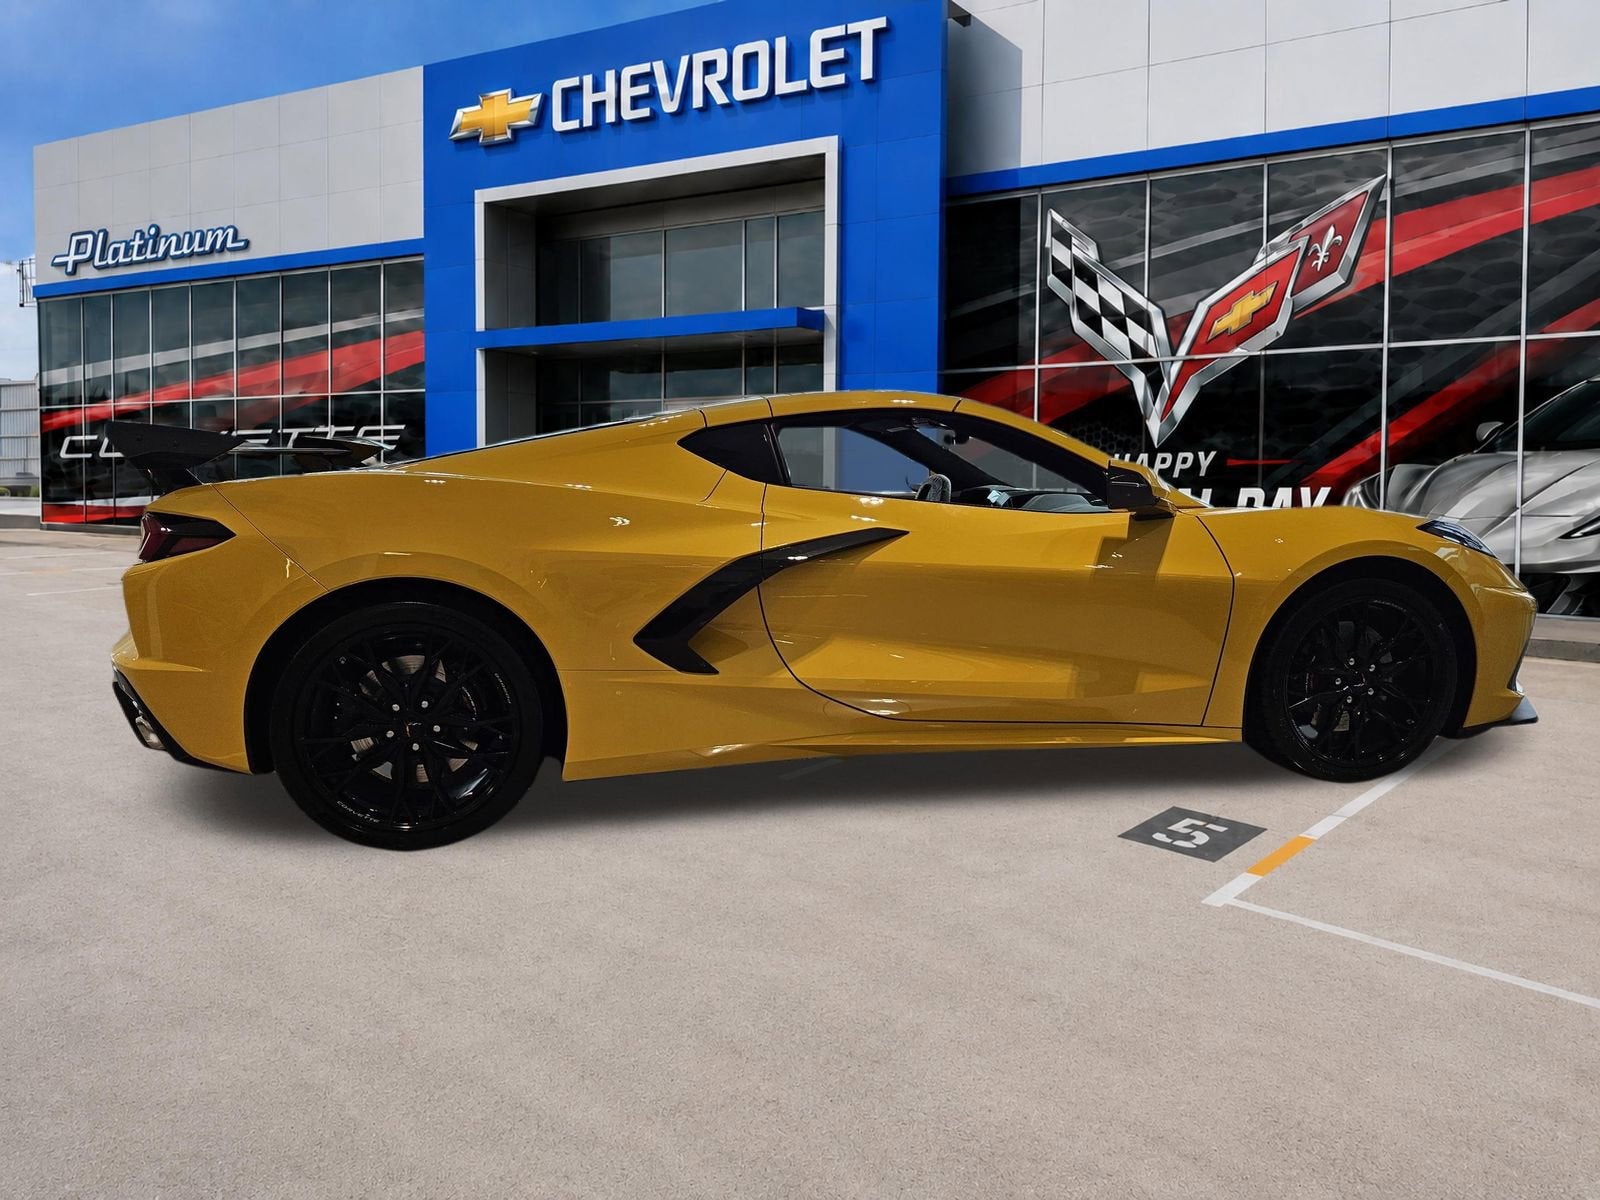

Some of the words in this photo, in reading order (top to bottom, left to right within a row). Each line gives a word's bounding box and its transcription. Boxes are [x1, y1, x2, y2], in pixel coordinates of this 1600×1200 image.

[552, 16, 887, 133] CHEVROLET
[51, 224, 250, 275] Platinum
[1152, 817, 1229, 848] 5
